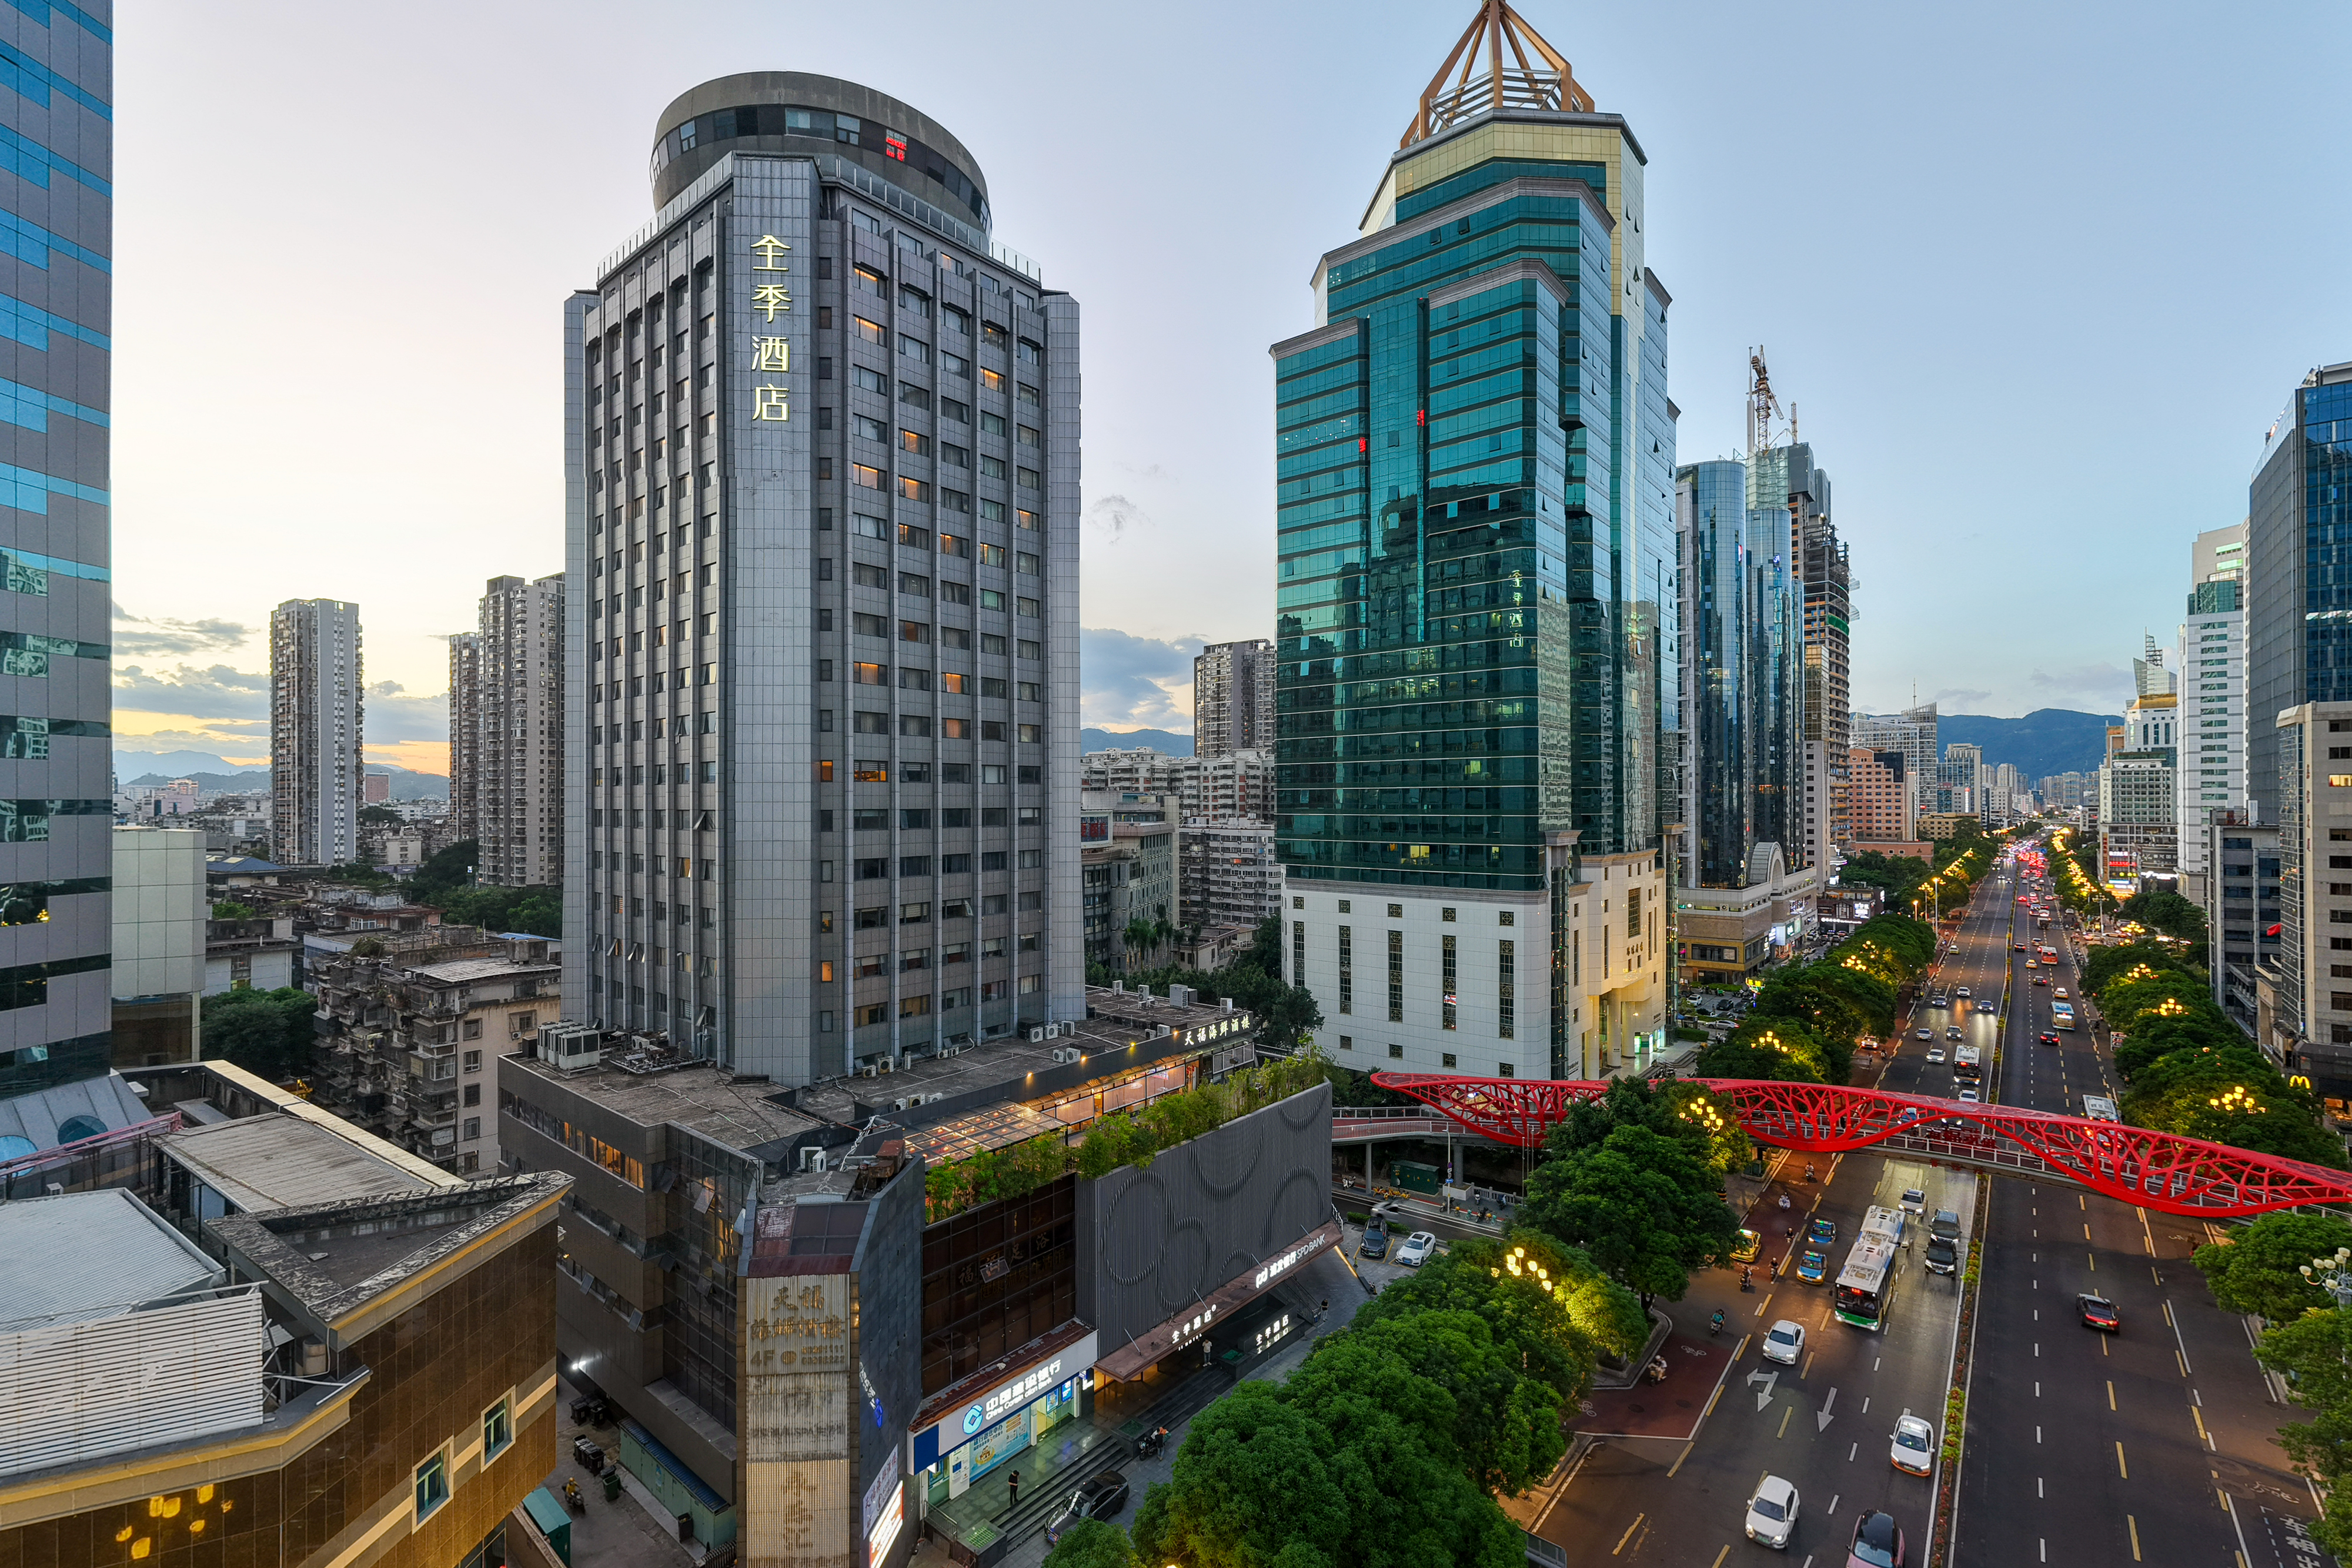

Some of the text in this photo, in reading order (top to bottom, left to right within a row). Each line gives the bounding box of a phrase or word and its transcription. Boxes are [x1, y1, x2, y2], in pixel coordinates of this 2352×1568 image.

[750, 235, 792, 422] 全季酒店
[1184, 1014, 1251, 1046] 天福海鲜酒楼
[1297, 1233, 1325, 1259] SPD BANK
[980, 1248, 1066, 1300] 健康温泉生活馆
[1269, 1251, 1297, 1278] 浦发银行
[771, 1285, 824, 1310] 天福
[1172, 1309, 1211, 1344] 全季酒店
[1256, 1314, 1289, 1346] 全季酒店
[750, 1350, 775, 1367] 4F
[986, 1359, 1061, 1412] 中国建设银行
